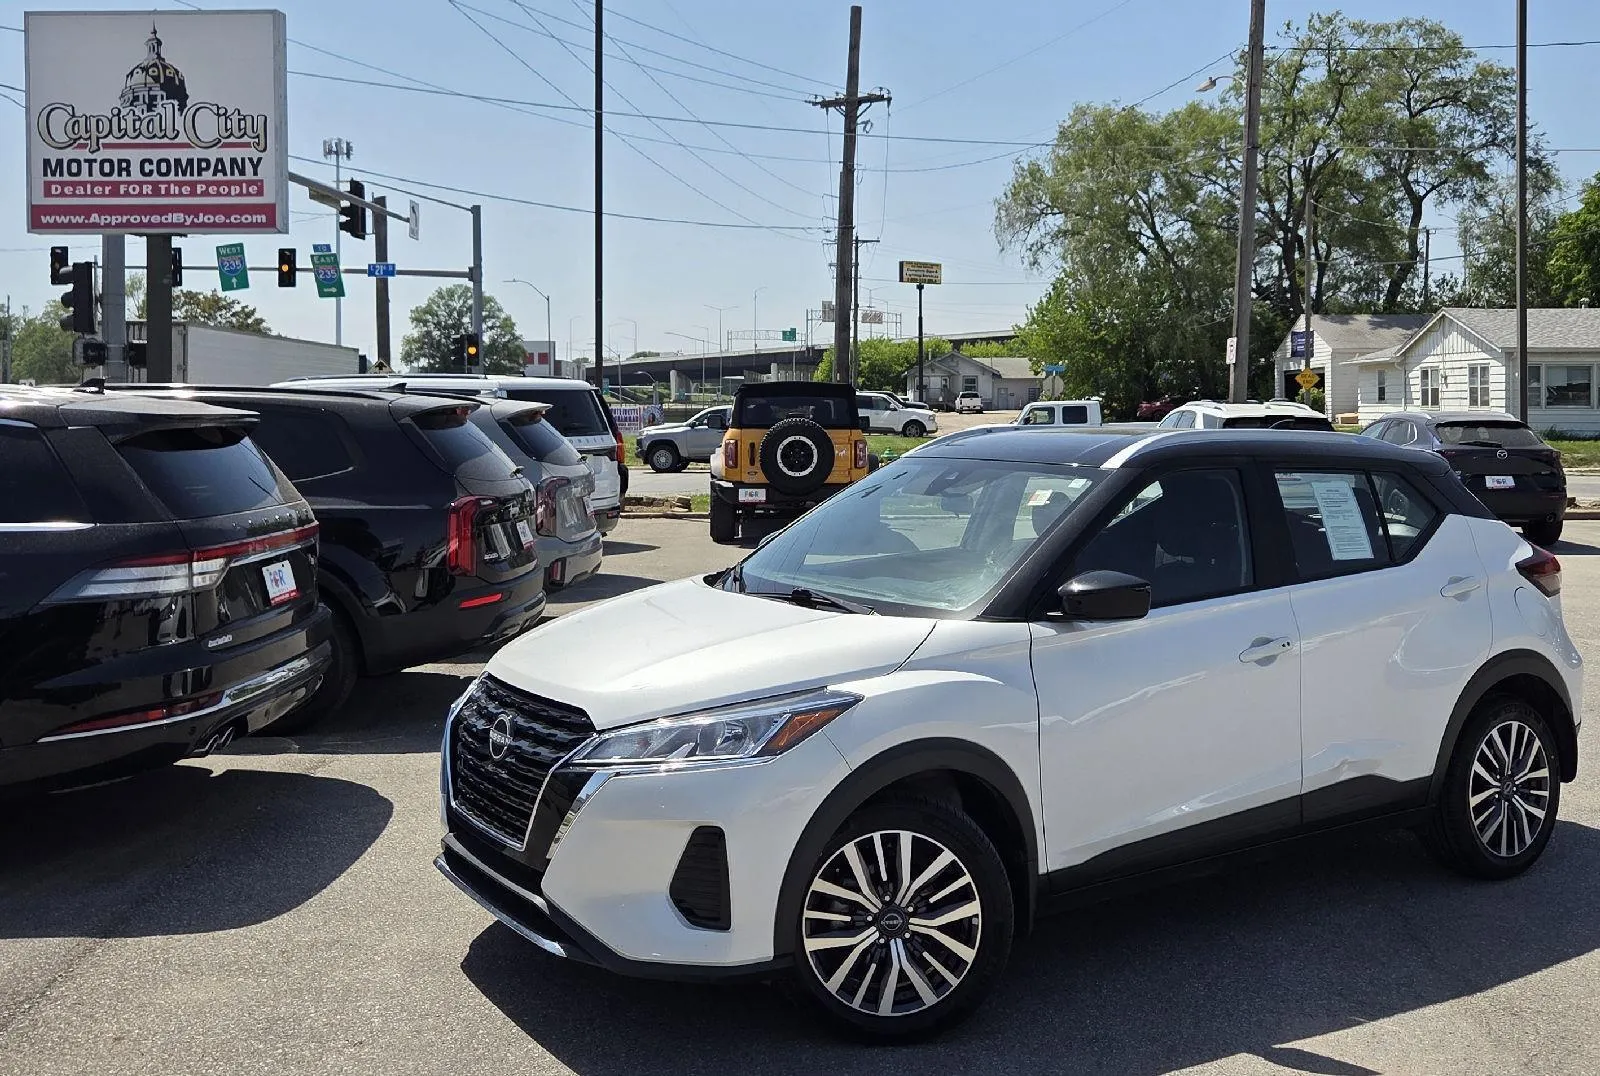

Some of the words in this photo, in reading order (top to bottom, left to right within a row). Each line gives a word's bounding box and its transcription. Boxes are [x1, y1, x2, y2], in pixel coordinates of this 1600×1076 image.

[37, 102, 178, 153] Capital
[184, 102, 267, 153] City
[42, 158, 131, 177] MOTOR
[140, 157, 263, 177] COMPANY
[51, 183, 112, 195] Dealer
[120, 184, 152, 195] FOR
[159, 183, 191, 195] The
[197, 183, 258, 196] People
[40, 213, 267, 226] www.ApprovedByJoe.com
[218, 246, 241, 255] WEST
[224, 260, 242, 271] 235
[314, 256, 335, 264] EAST
[318, 269, 337, 279] 235
